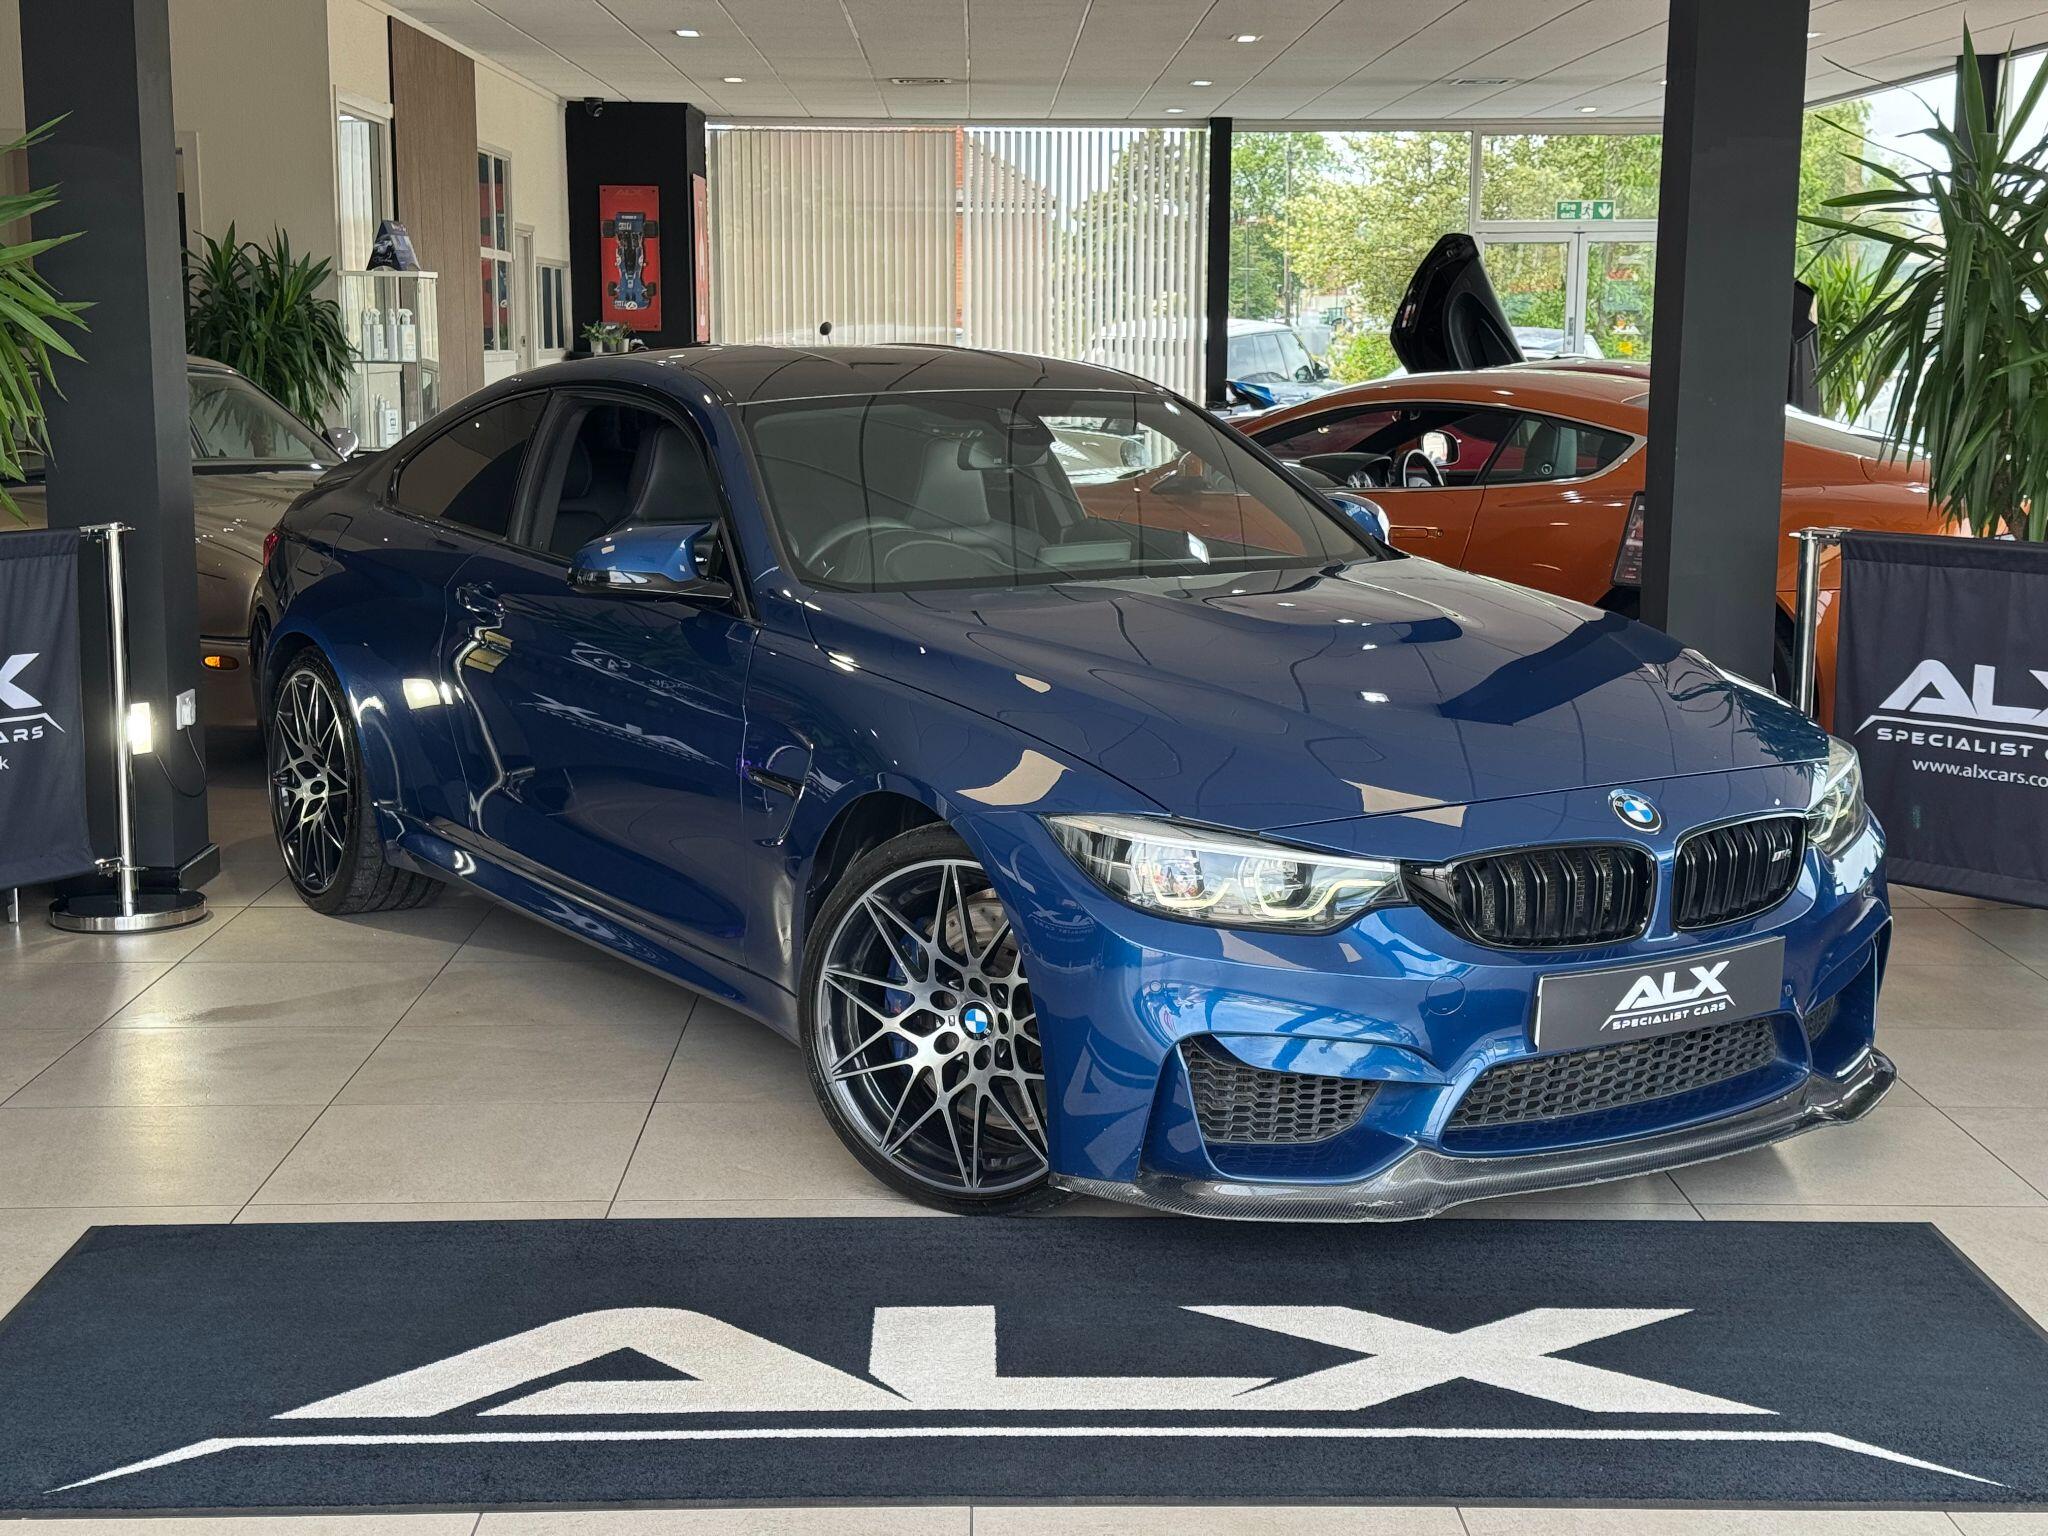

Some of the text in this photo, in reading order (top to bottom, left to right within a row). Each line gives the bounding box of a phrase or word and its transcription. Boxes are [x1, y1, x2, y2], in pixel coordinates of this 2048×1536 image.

[1560, 202, 1577, 211] Fire
[1560, 210, 1576, 219] exit
[1876, 727, 2034, 758] SPECIALIST
[1614, 960, 1730, 1012] ALX
[1612, 1001, 1727, 1031] SPECIALIST CARS
[270, 1305, 1780, 1420] ALX
